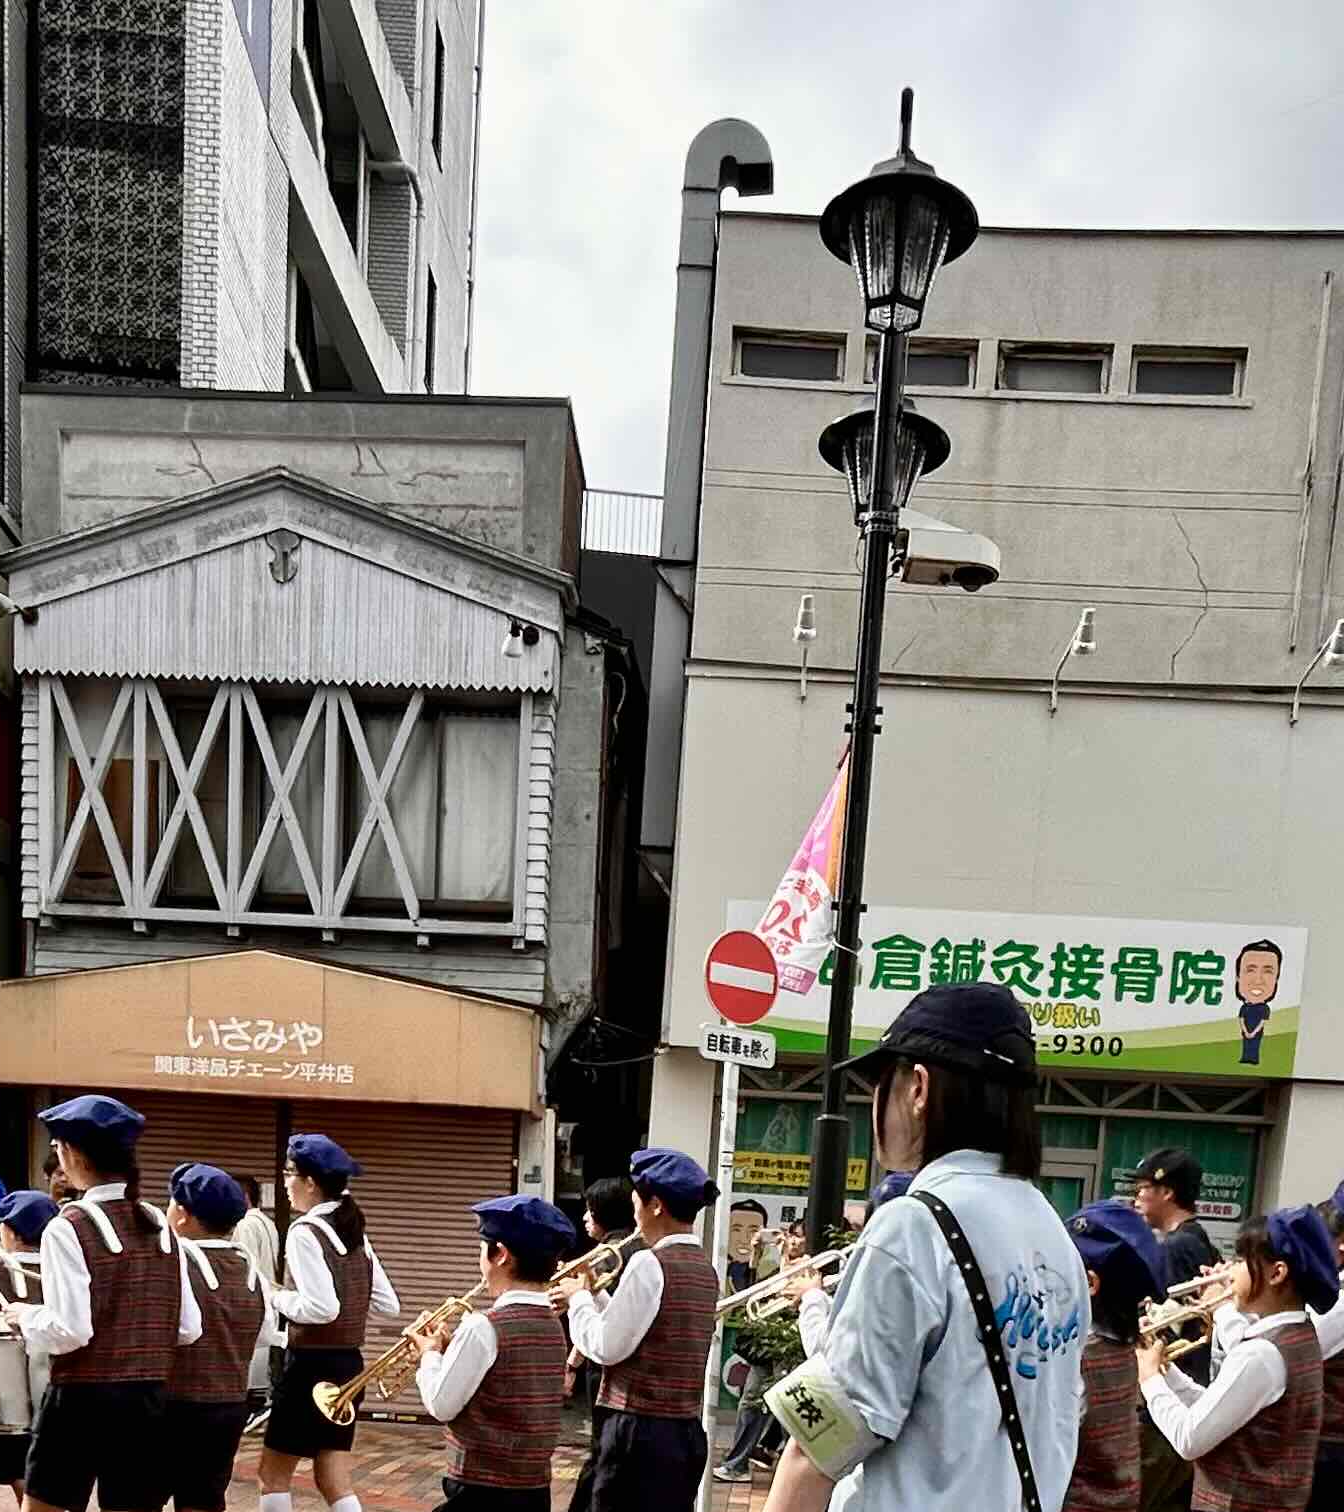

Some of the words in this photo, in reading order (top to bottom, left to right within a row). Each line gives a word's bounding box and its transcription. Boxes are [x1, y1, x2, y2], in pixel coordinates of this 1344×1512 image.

[186, 1017, 323, 1054] いさみや
[1031, 1033, 1123, 1056] -9300
